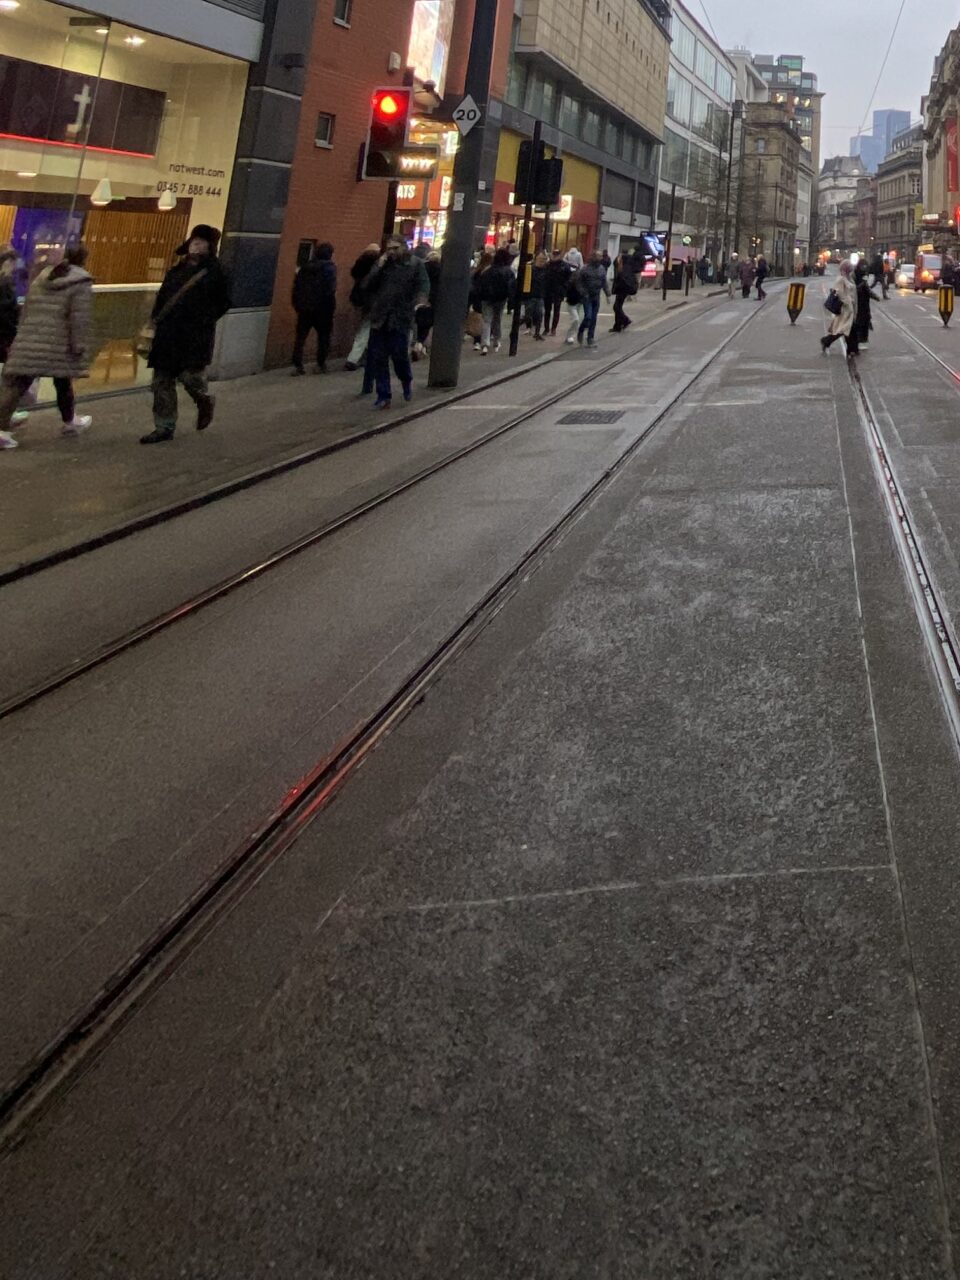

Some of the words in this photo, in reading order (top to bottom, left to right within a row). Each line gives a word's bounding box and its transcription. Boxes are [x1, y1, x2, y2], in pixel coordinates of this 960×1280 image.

[456, 109, 477, 121] 20
[169, 164, 225, 178] natwest.com
[157, 181, 178, 193] 0345
[181, 183, 187, 194] 7
[188, 184, 204, 196] 888
[206, 186, 221, 197] 444
[397, 184, 416, 199] ATS
